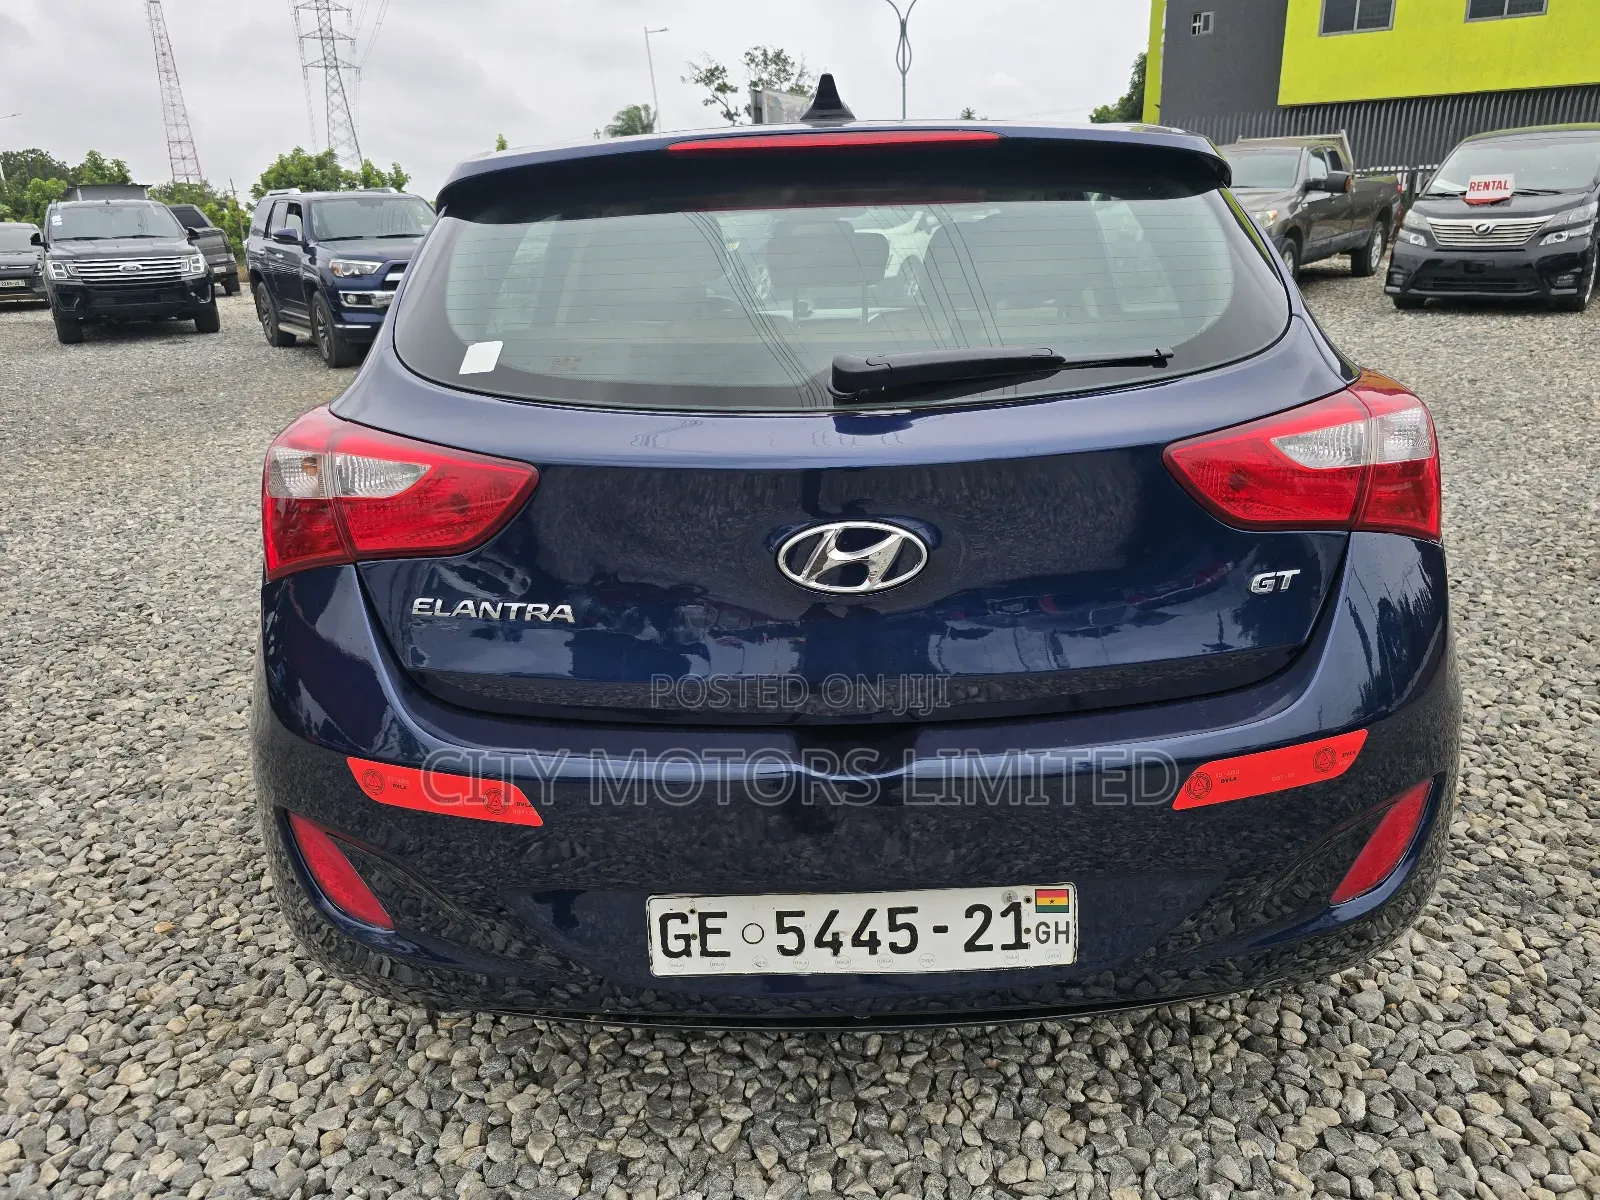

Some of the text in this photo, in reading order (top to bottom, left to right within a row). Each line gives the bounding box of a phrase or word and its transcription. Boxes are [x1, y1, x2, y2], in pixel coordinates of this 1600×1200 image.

[1468, 180, 1510, 192] RENTAL
[1250, 568, 1301, 594] GT
[411, 597, 576, 623] ELANTRA
[1220, 776, 1237, 784] DVLA
[658, 911, 731, 958] GE
[1035, 920, 1070, 945] GH
